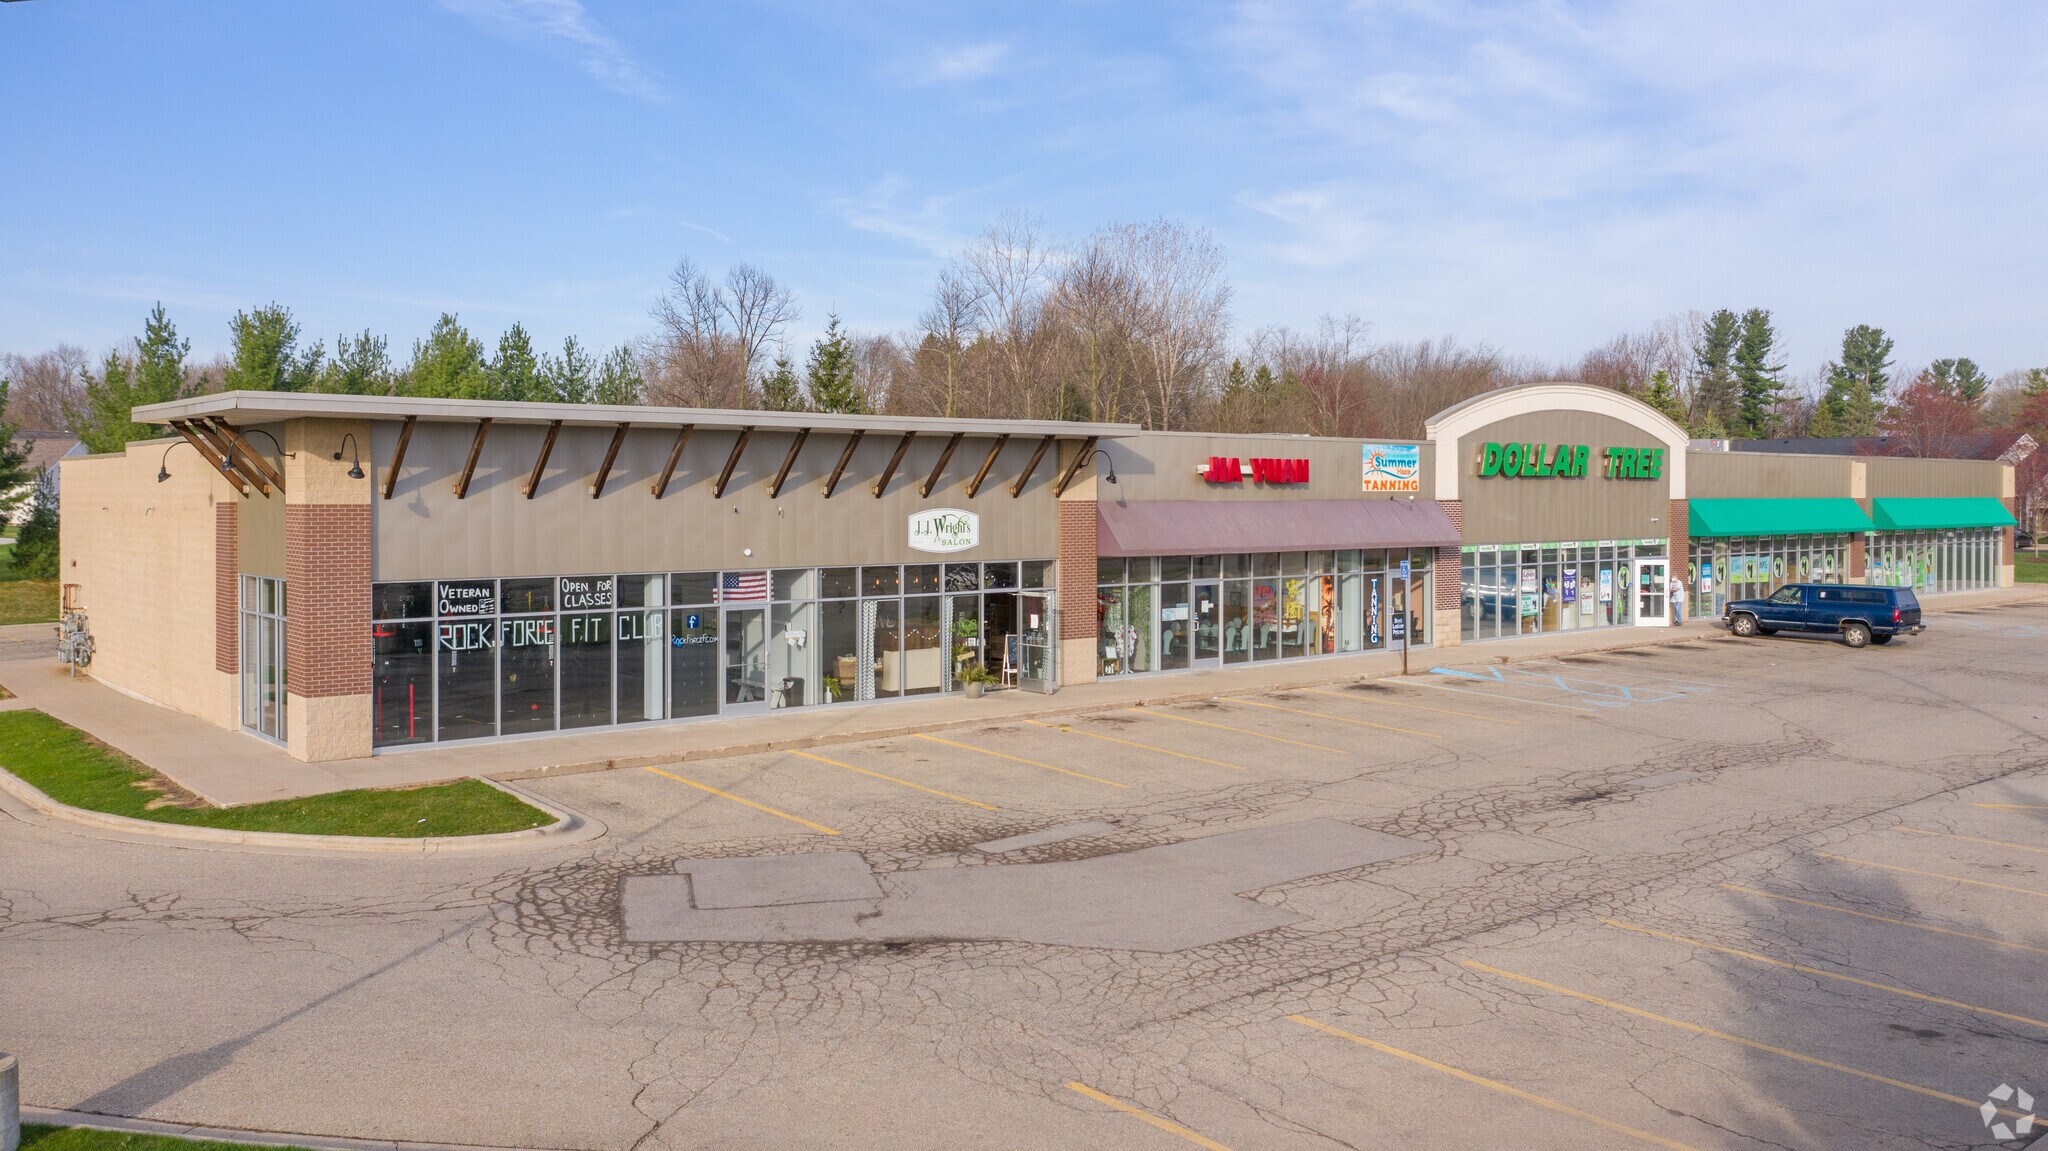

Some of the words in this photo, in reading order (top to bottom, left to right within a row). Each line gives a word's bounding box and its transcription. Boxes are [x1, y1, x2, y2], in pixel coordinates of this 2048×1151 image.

[1375, 456, 1417, 468] Summer
[1480, 442, 1590, 477] DOLLAR
[1604, 447, 1664, 479] TREE
[1203, 456, 1243, 482] JIA
[1249, 458, 1309, 482] YUAN
[1364, 480, 1418, 490] TANNING
[914, 520, 932, 536] J.J.
[440, 585, 490, 599] VETERAN
[562, 579, 588, 592] OPEN
[597, 580, 612, 591] FOR
[440, 600, 478, 613] OWNED
[564, 592, 613, 608] CLASSES
[1370, 578, 1378, 643] TANNING
[438, 624, 492, 650] ROCK
[500, 620, 554, 647] FORCE
[572, 619, 602, 643] FIT
[619, 614, 663, 640] CLUB
